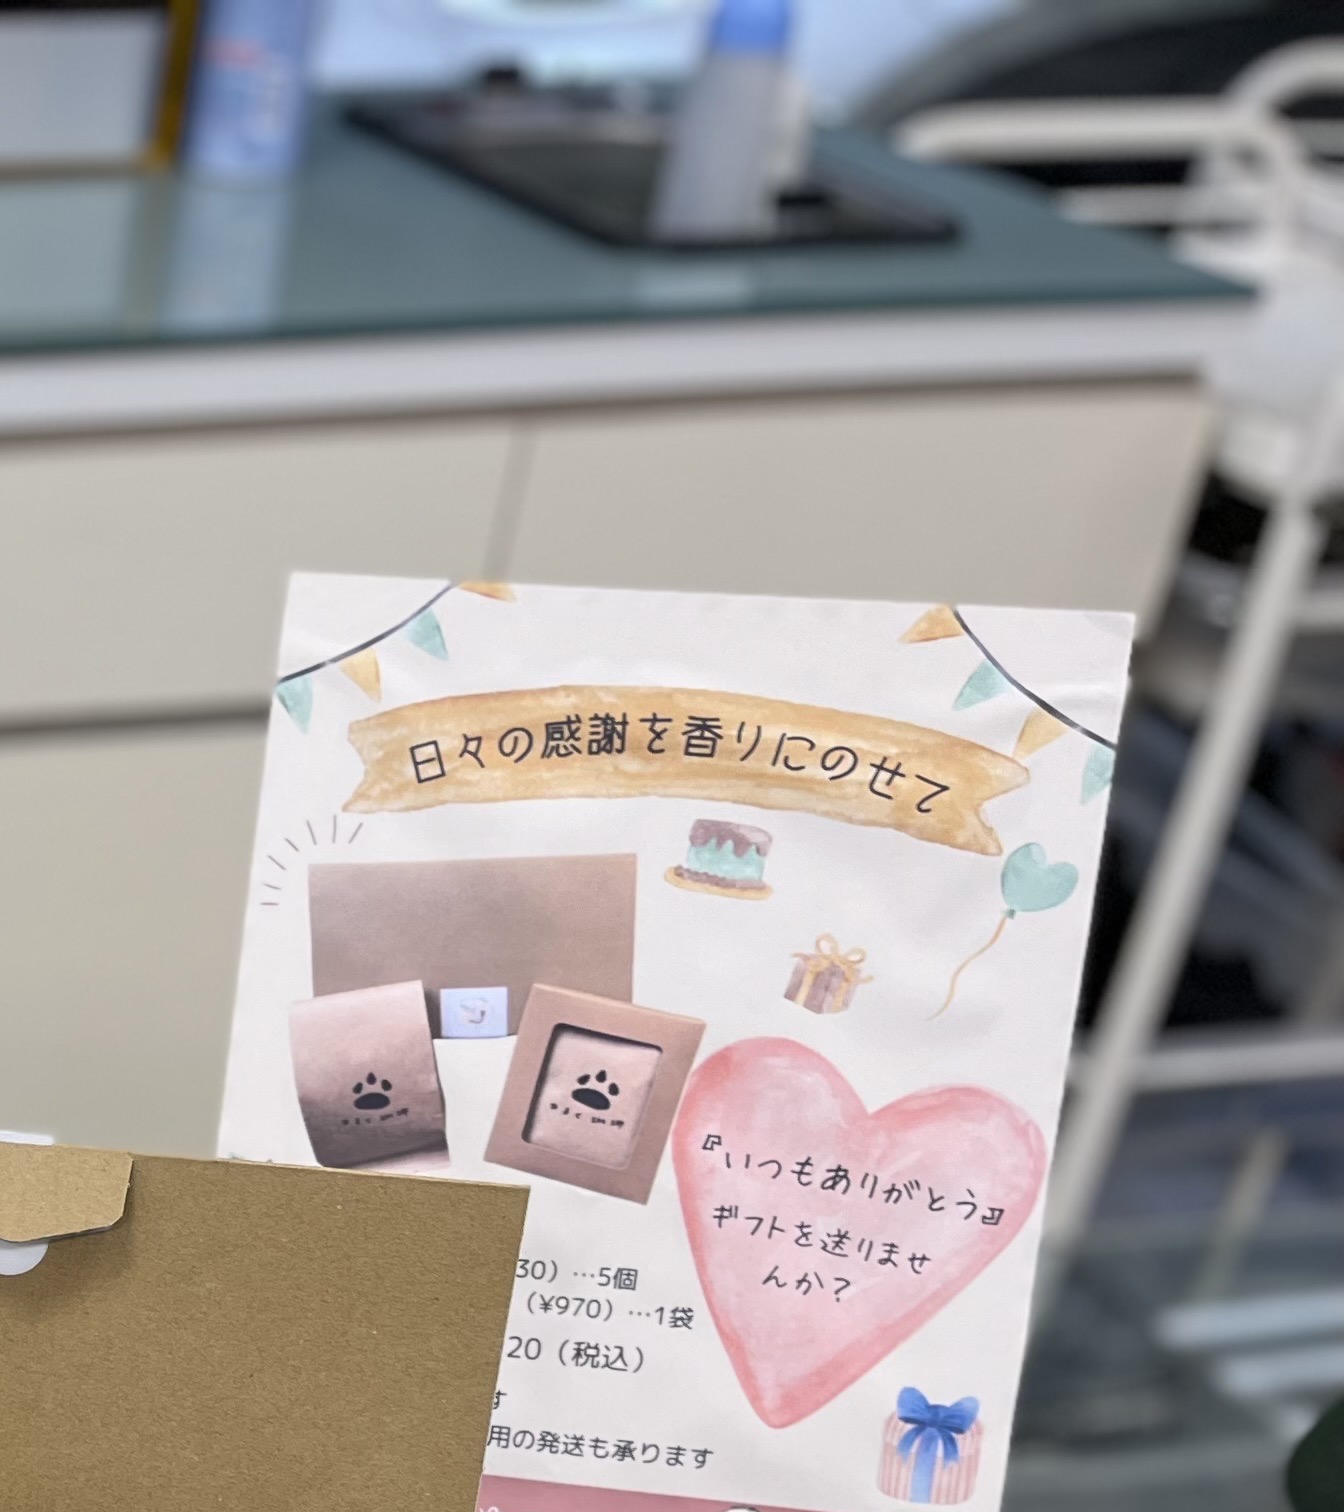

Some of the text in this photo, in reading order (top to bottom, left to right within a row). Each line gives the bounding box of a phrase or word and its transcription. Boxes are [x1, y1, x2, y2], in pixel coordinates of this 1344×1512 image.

[409, 712, 951, 814] 日々の感謝を香りにのせて
[701, 1133, 1005, 1226] 『いつもありがとう』
[712, 1204, 932, 1275] ギフトを送りませ
[761, 1265, 852, 1303] んか？
[485, 1424, 715, 1470] 用の発送も承ります
